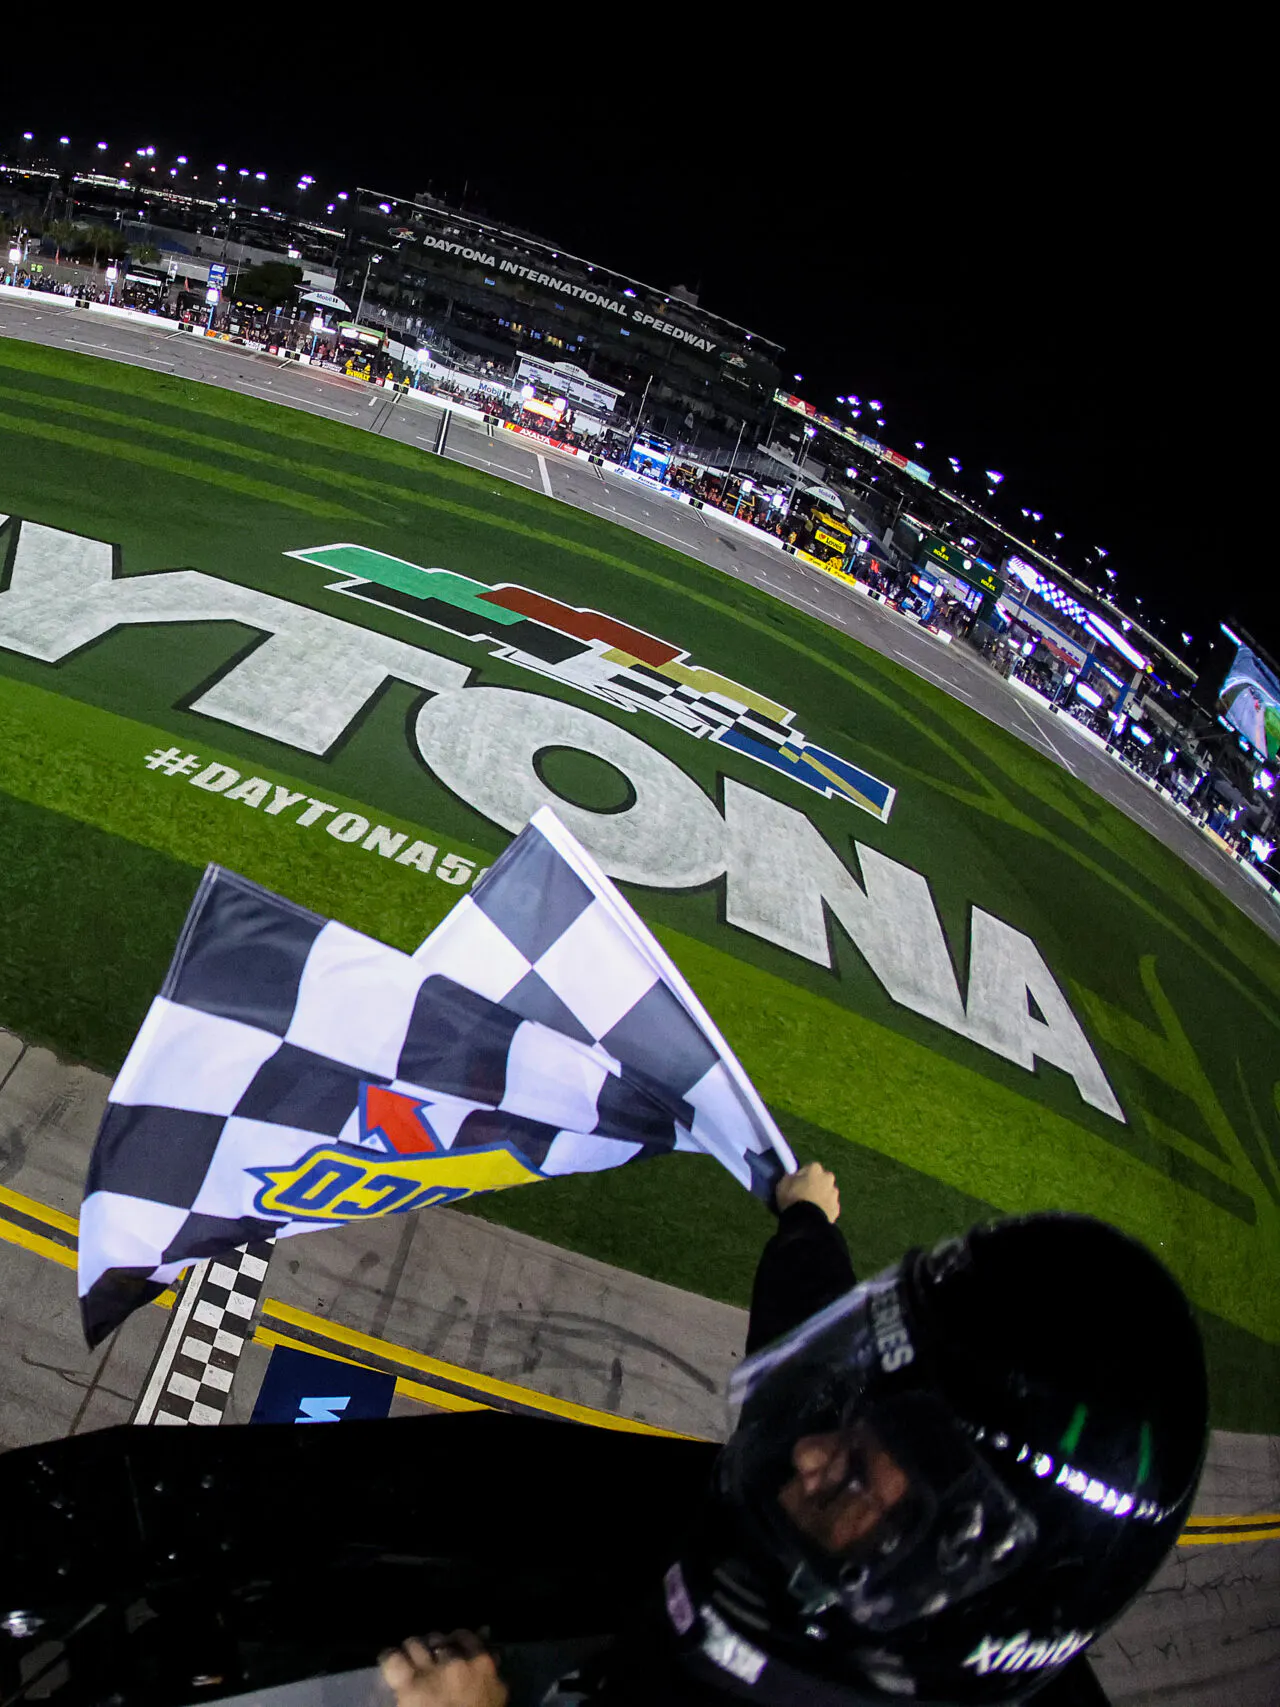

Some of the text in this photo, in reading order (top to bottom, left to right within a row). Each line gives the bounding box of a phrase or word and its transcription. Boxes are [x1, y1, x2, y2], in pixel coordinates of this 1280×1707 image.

[423, 235, 717, 353] DAYTONA INTERNATIONAL SPEEDWAY
[478, 382, 502, 398] Mobil
[520, 428, 551, 445] AXALTA
[933, 548, 949, 561] ROLEX
[980, 578, 996, 591] ROLEX
[144, 747, 488, 888] #DAYTONA5
